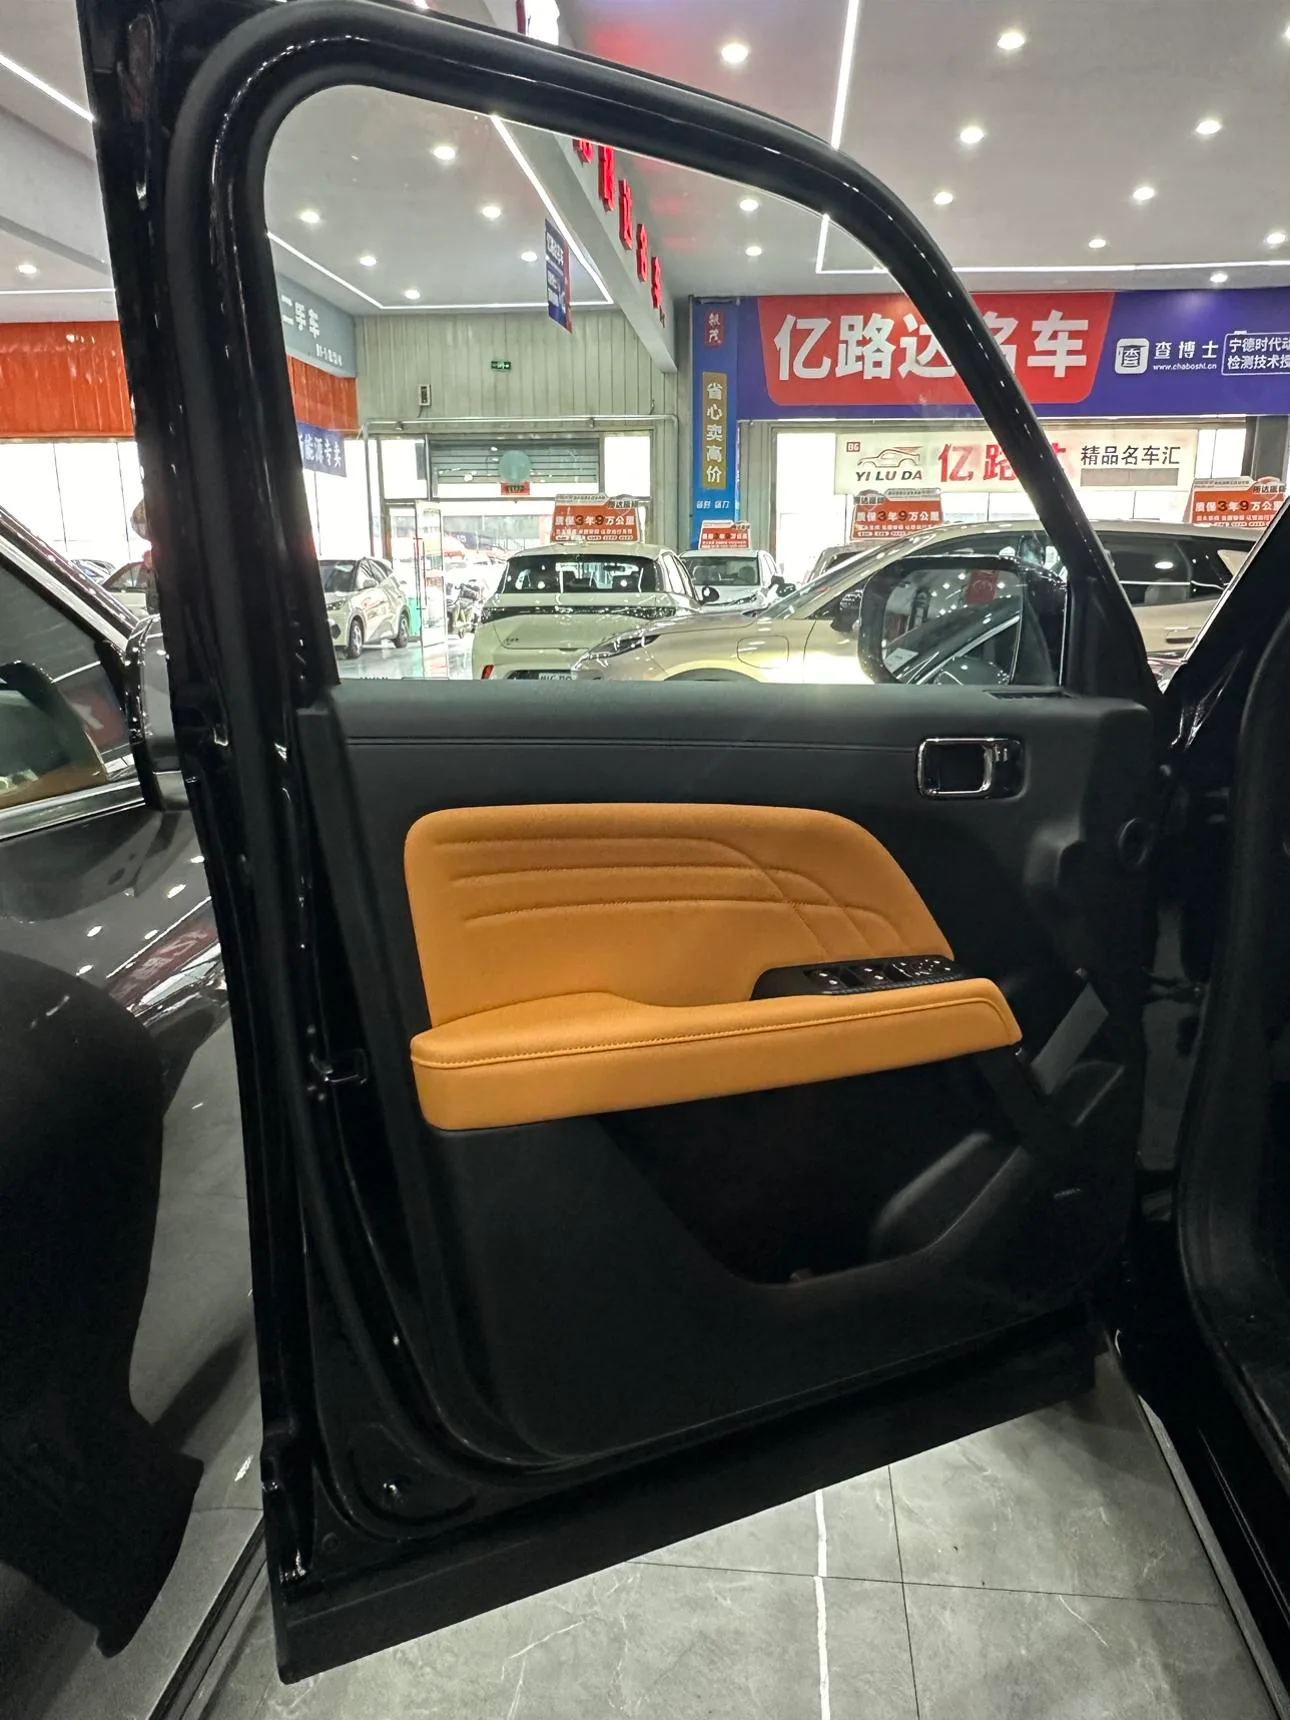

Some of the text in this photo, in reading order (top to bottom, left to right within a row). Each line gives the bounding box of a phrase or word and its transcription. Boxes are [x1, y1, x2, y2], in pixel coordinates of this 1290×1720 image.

[1154, 340, 1220, 360] 查博士
[1153, 361, 1217, 371] www.chaboshi.cn
[706, 382, 723, 484] 省心卖高价
[938, 442, 1067, 482] 亿路
[1080, 444, 1182, 466] 精品名车汇
[855, 470, 923, 482] YI LU DA
